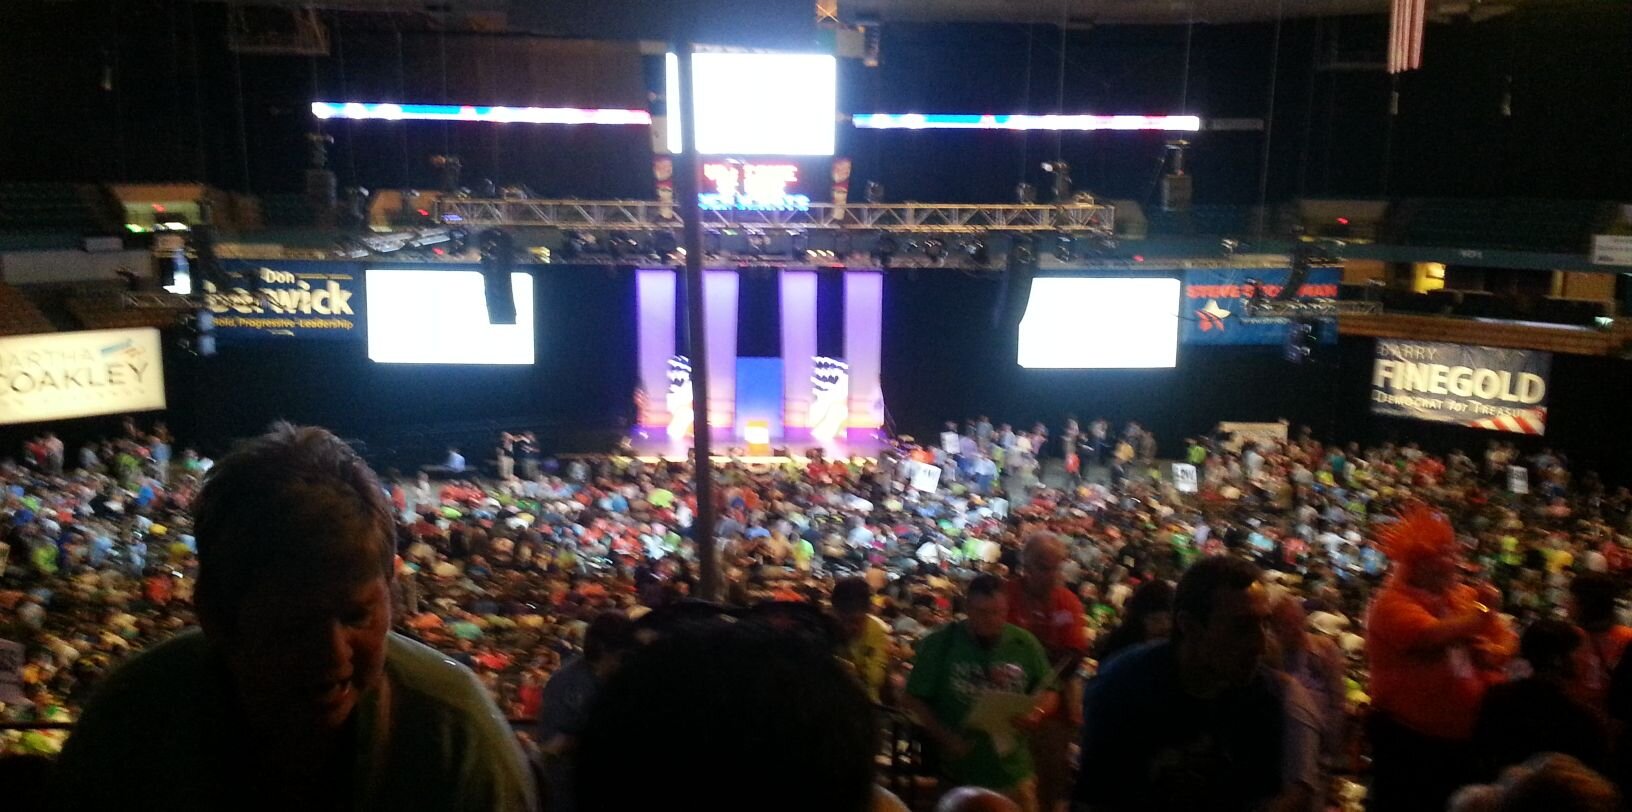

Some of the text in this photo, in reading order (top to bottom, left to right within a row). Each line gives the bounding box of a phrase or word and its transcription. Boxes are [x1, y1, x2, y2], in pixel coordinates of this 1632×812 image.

[259, 266, 296, 284] Don
[1186, 284, 1240, 299] STEVE
[0, 348, 95, 369] ARTHA
[1372, 358, 1547, 404] FINEGOLD
